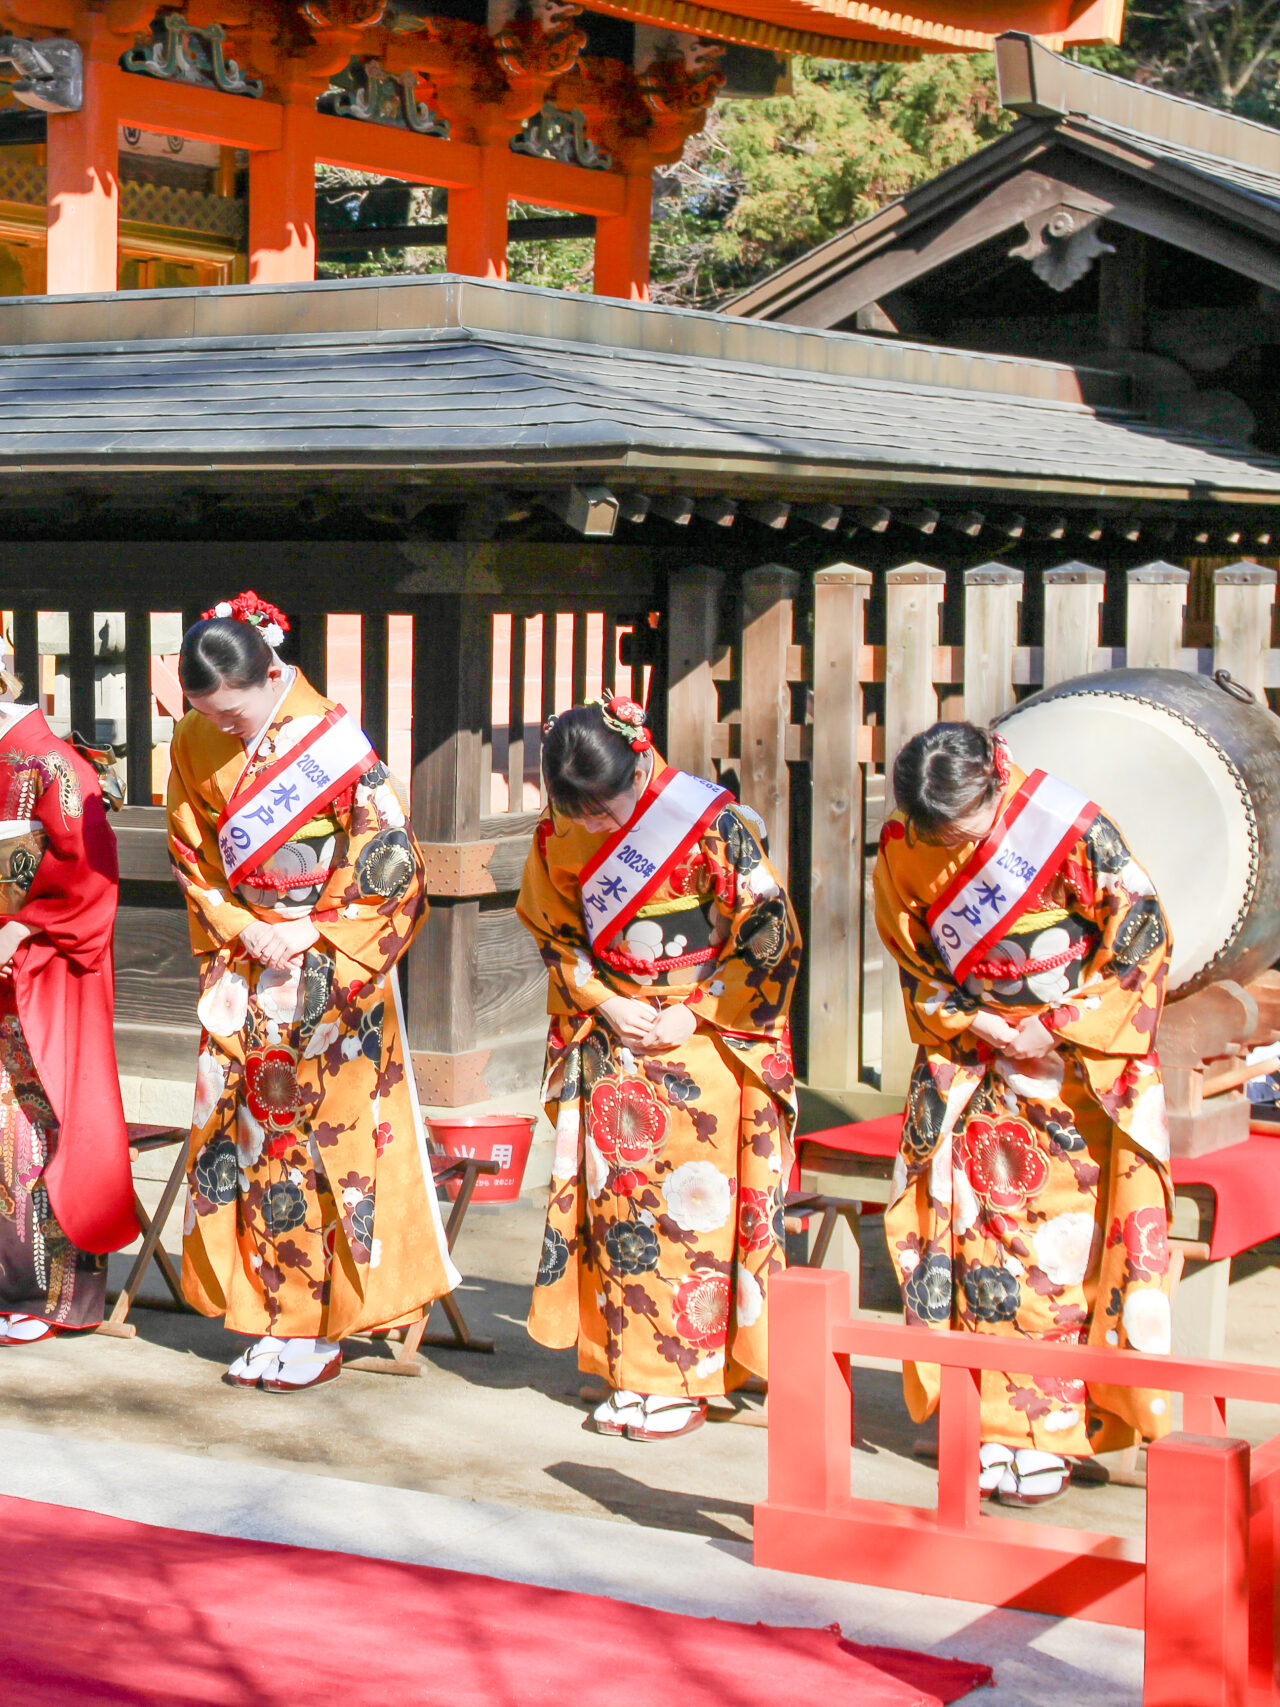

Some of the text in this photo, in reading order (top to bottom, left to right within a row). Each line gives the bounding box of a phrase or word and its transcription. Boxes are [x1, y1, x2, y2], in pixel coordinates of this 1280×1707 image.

[296, 754, 331, 788] 2023年
[220, 783, 300, 868] 水戸の梅
[616, 845, 656, 878] 2023年
[996, 849, 1037, 883] 2023年
